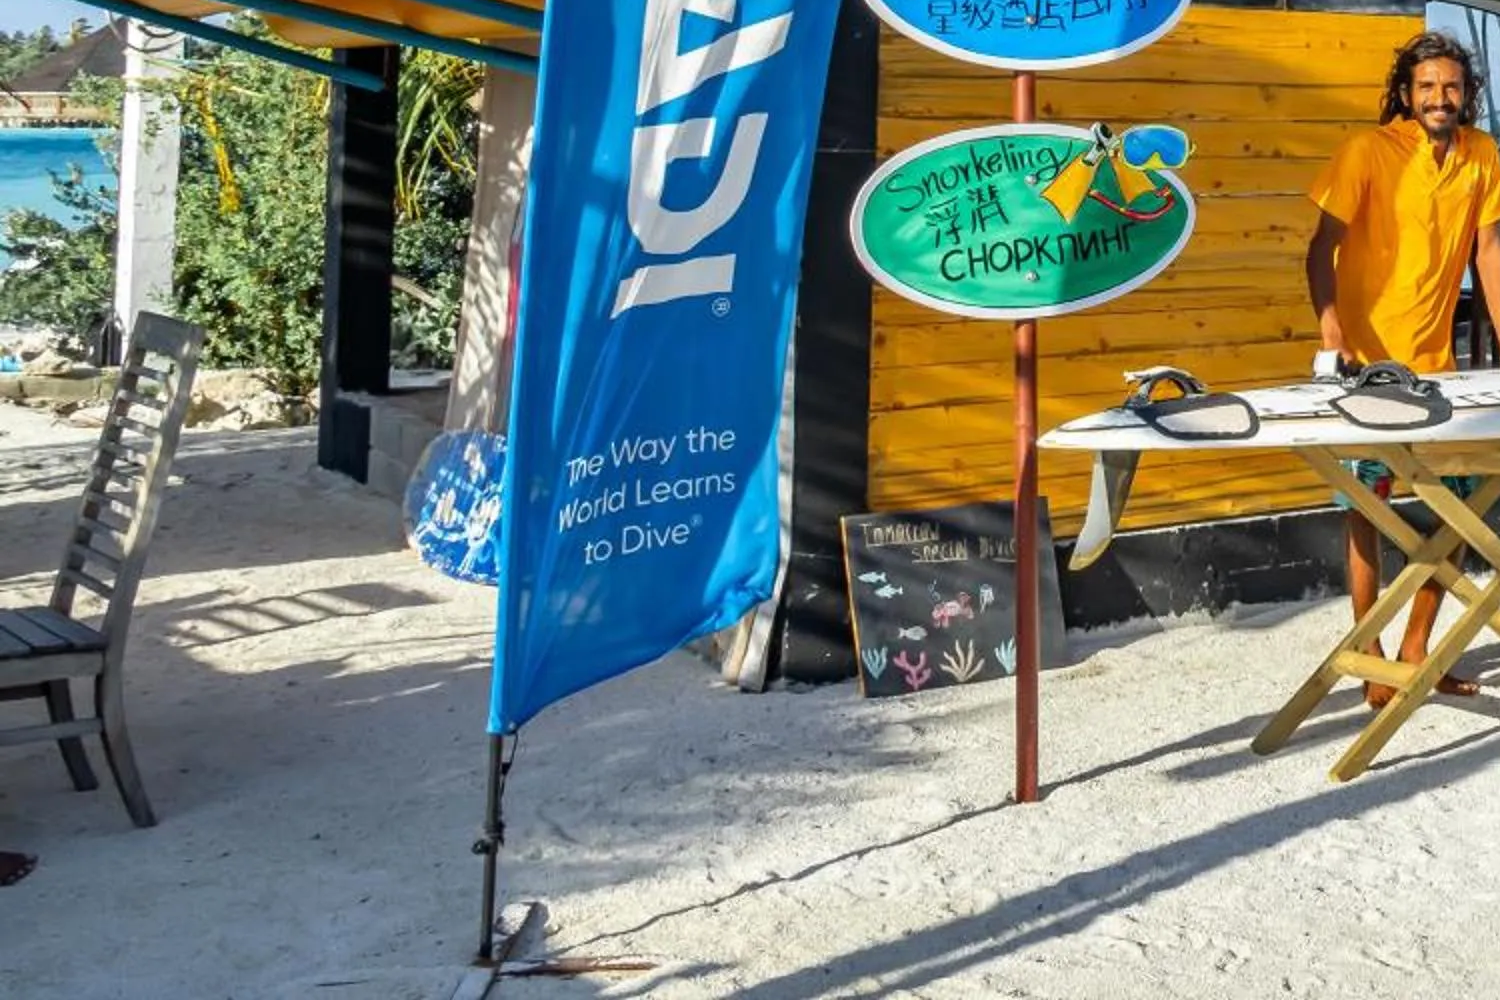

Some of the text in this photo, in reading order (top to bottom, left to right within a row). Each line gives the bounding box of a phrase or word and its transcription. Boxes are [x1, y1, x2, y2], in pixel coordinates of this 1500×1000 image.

[886, 141, 1073, 212] Snorkeling
[565, 425, 736, 487] The Way the
[558, 472, 736, 534] World Learns
[583, 539, 613, 565] to
